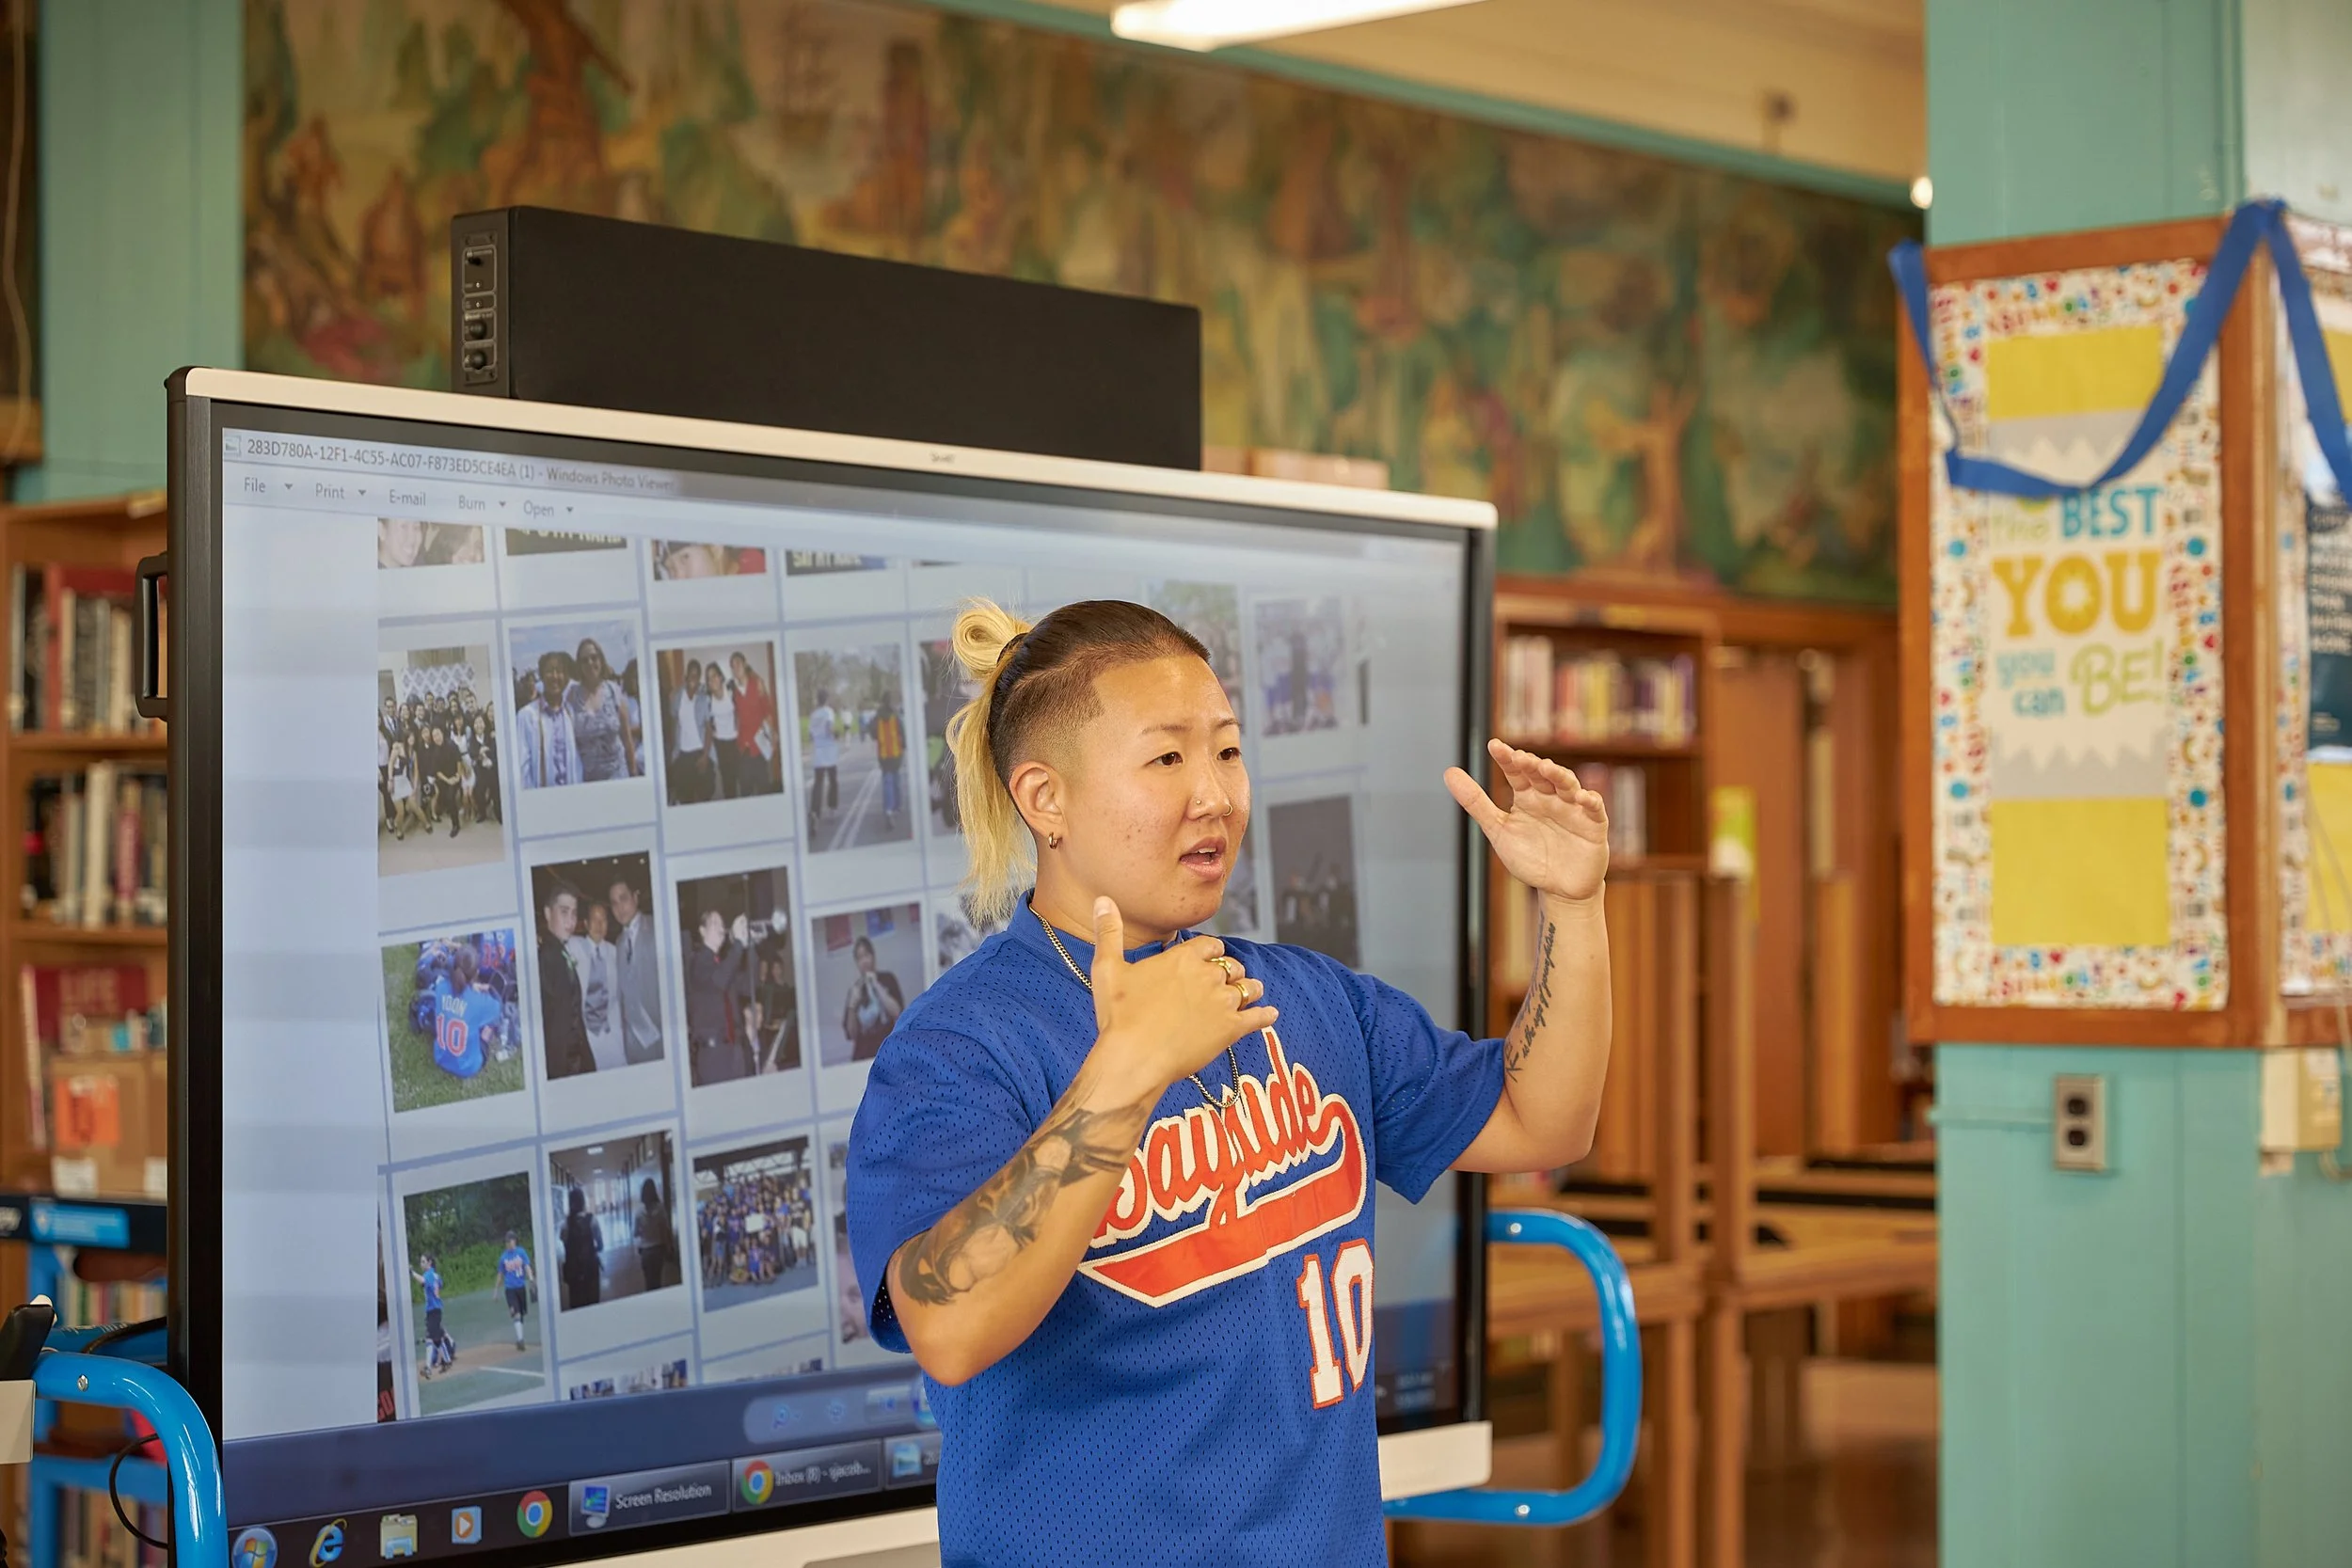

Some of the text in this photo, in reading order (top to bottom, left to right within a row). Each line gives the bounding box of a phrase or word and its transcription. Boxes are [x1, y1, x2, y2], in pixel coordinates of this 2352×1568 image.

[244, 477, 554, 518] File Print E-mail Burn Open
[519, 466, 535, 481] (1)
[547, 467, 598, 484] Windows
[601, 471, 635, 488] Photo
[637, 474, 675, 491] Viewer
[2059, 486, 2163, 538] BEST
[1991, 547, 2164, 640] YOU
[2069, 639, 2166, 717] BE!
[2013, 687, 2067, 719] can
[436, 1013, 469, 1057] 10
[1295, 1238, 1375, 1410] 10
[615, 1483, 712, 1510] Screen Resolution
[774, 1470, 805, 1486] Inbox
